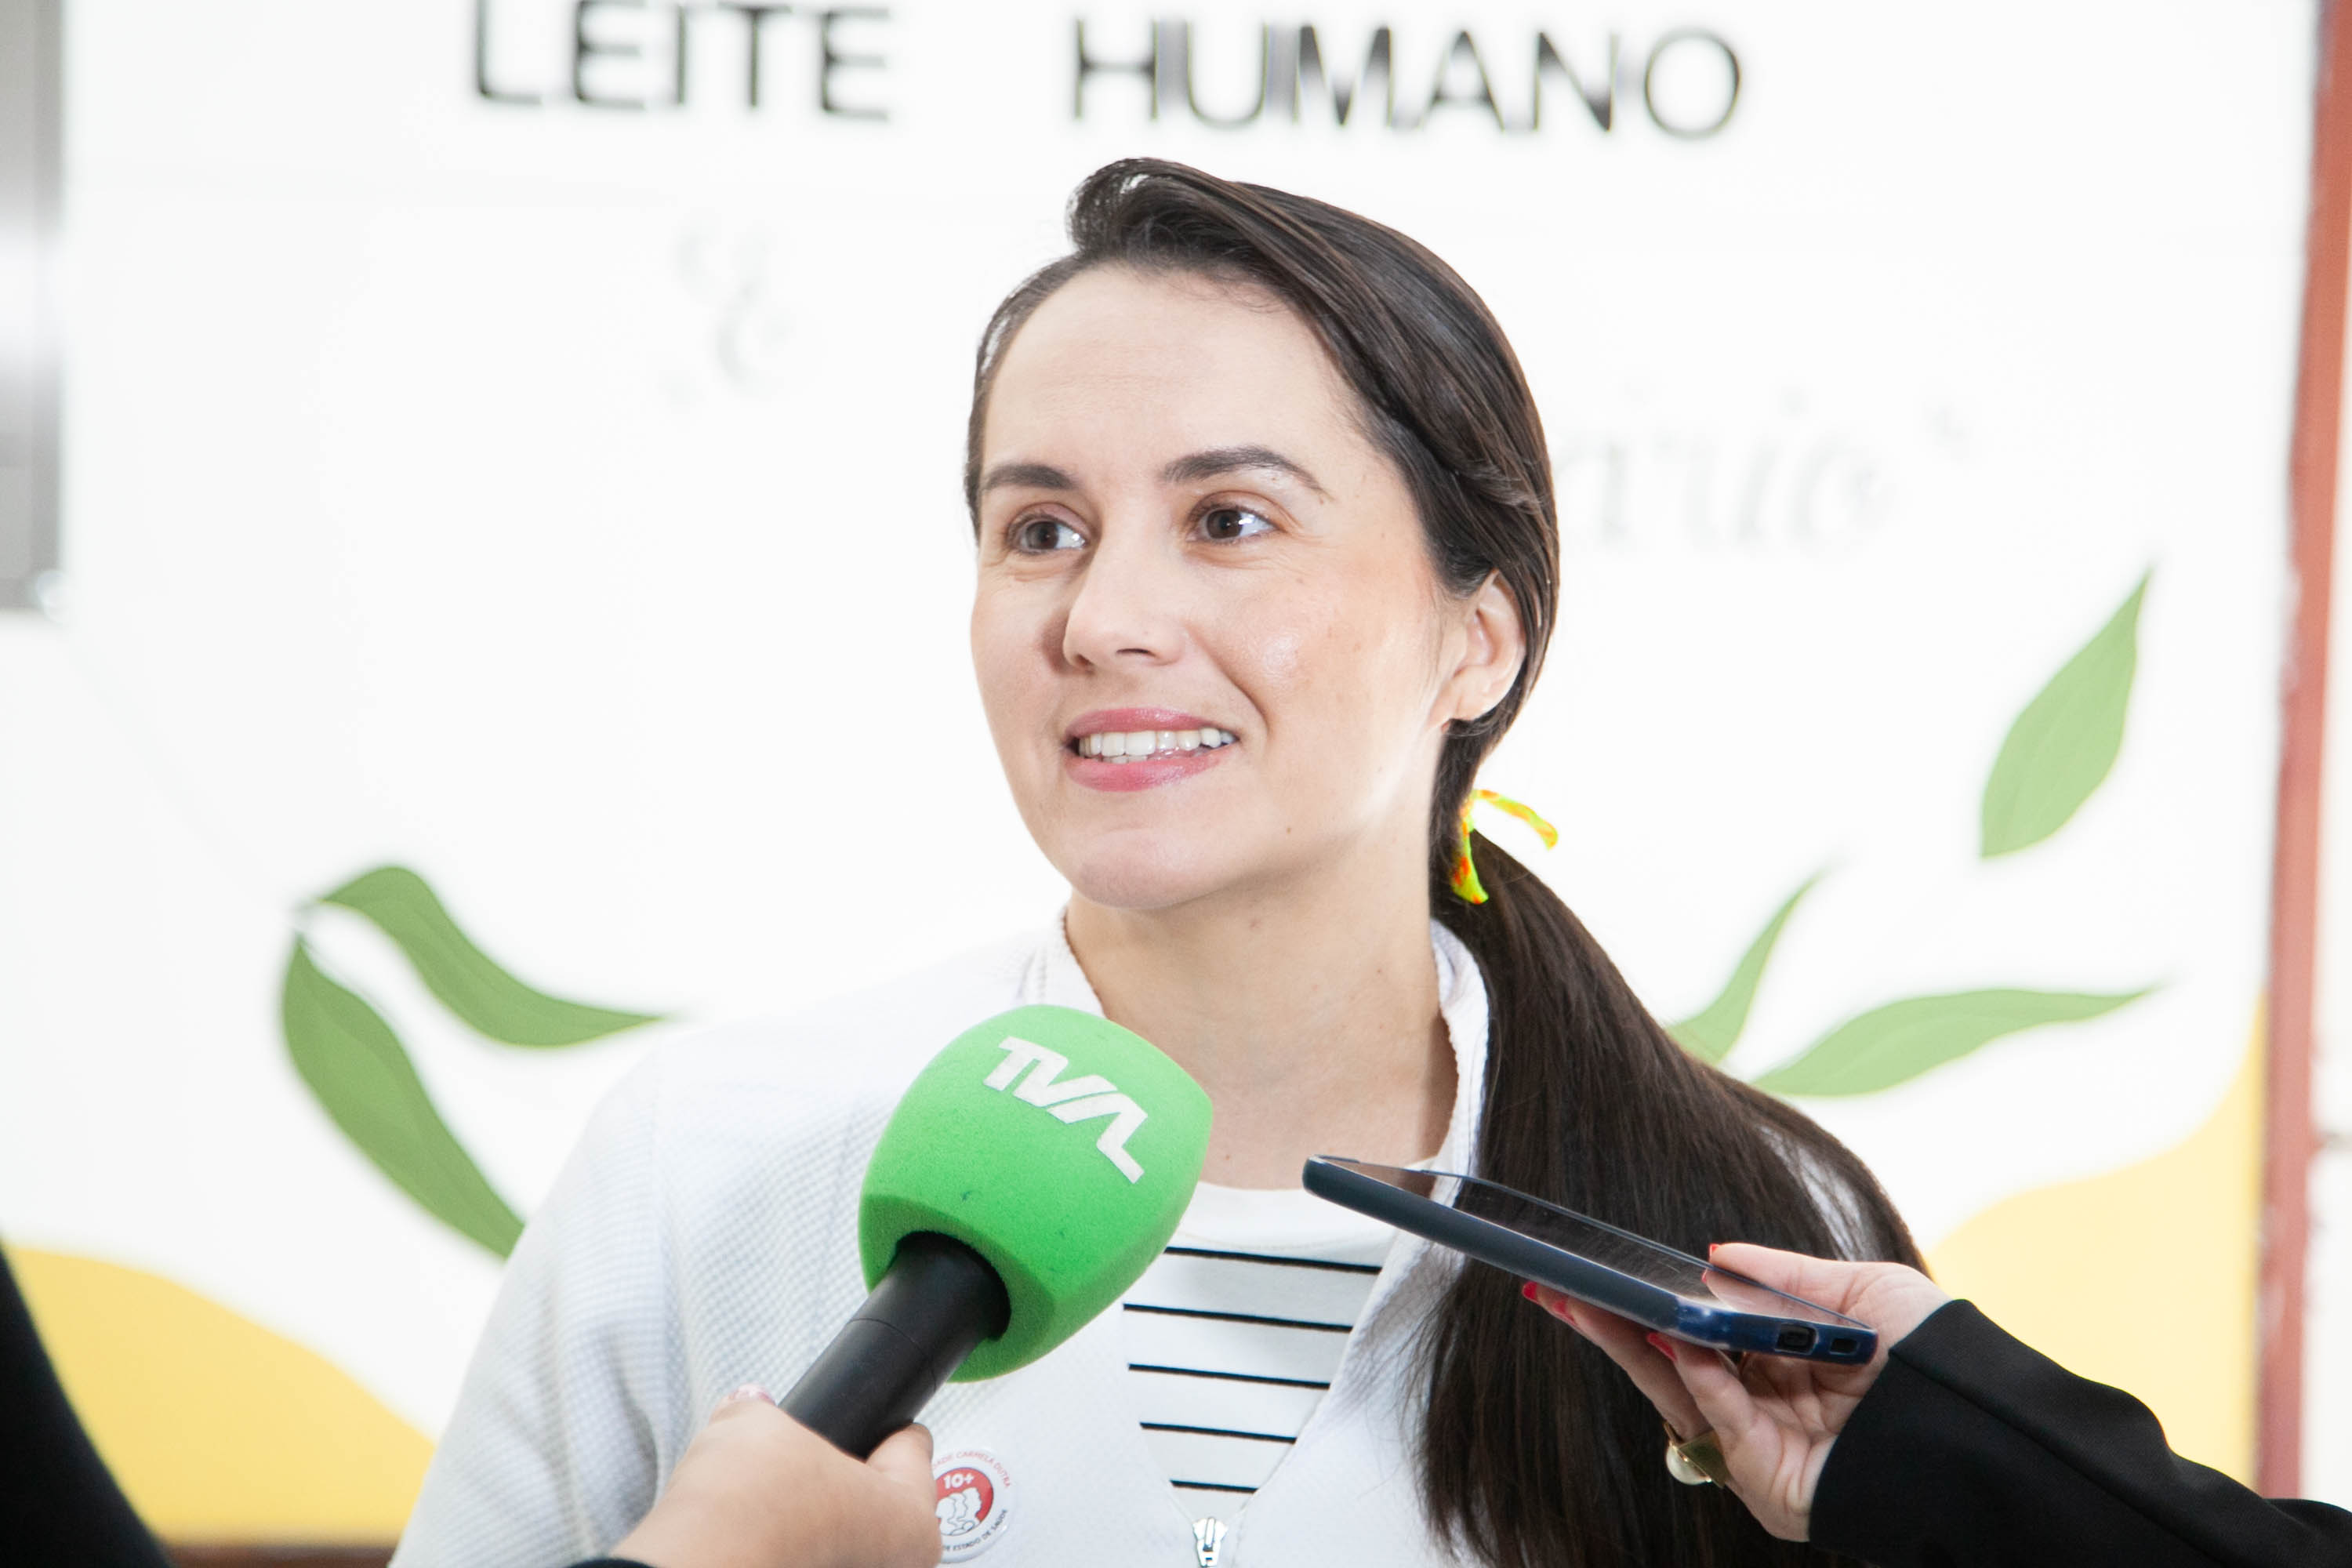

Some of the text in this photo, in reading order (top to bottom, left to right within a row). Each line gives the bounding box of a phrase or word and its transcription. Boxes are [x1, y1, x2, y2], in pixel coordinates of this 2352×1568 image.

[477, 0, 1742, 140] LEITE HUMANO
[944, 1473, 974, 1489] 10+
